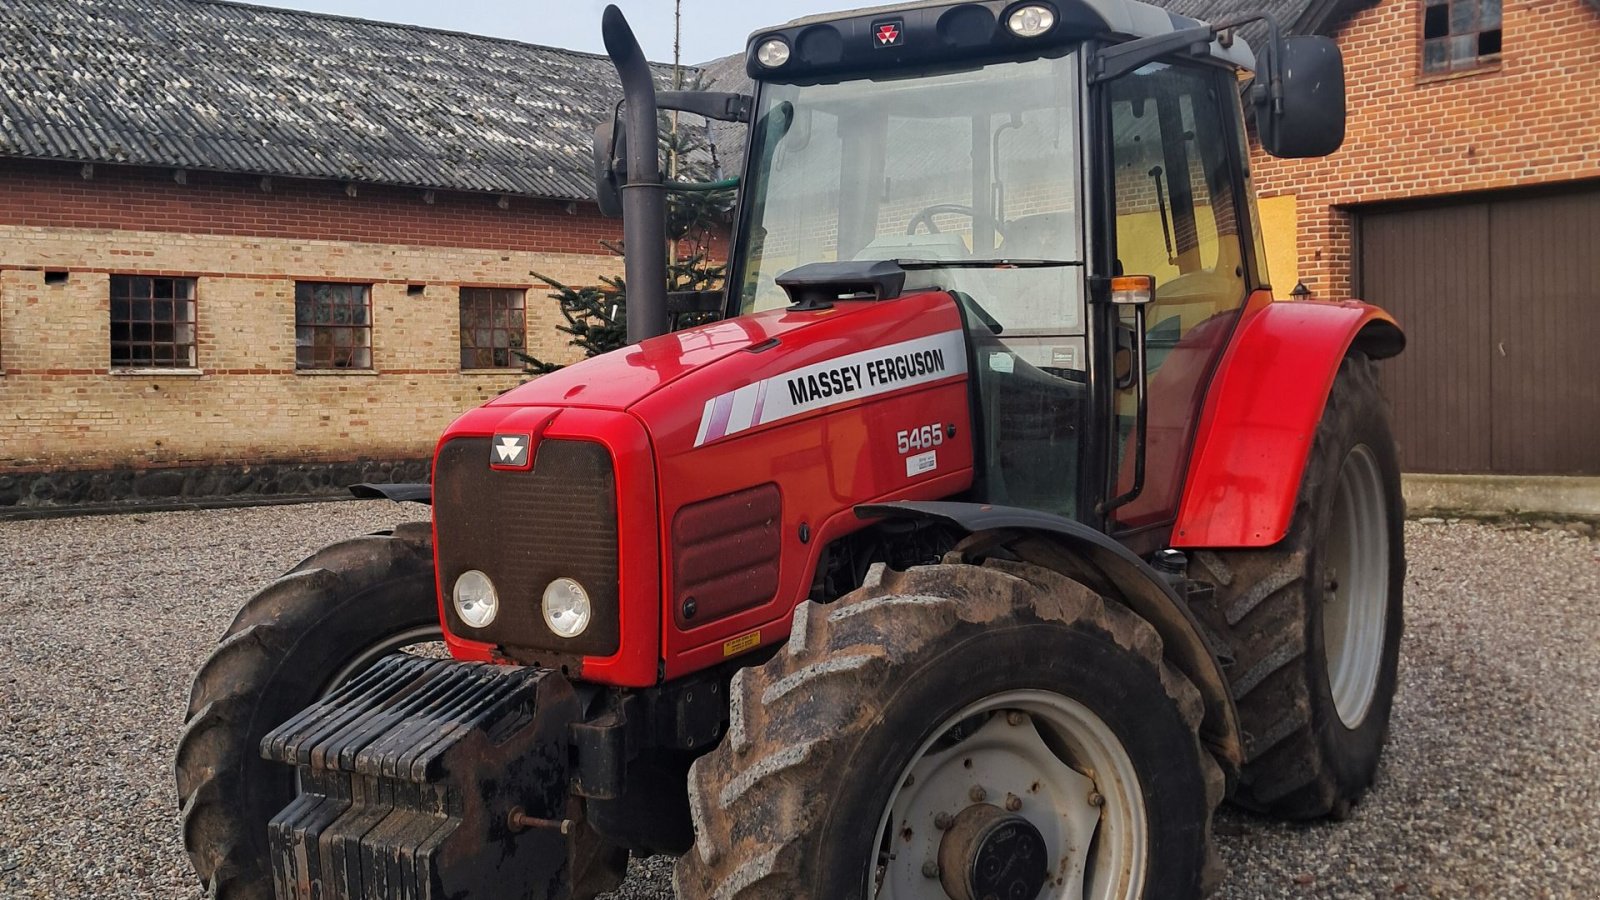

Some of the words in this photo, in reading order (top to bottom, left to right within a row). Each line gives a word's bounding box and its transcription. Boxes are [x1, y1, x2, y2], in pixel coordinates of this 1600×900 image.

[787, 364, 862, 406] MASSEY
[867, 348, 945, 386] FERGUSON
[896, 423, 943, 454] 5465
